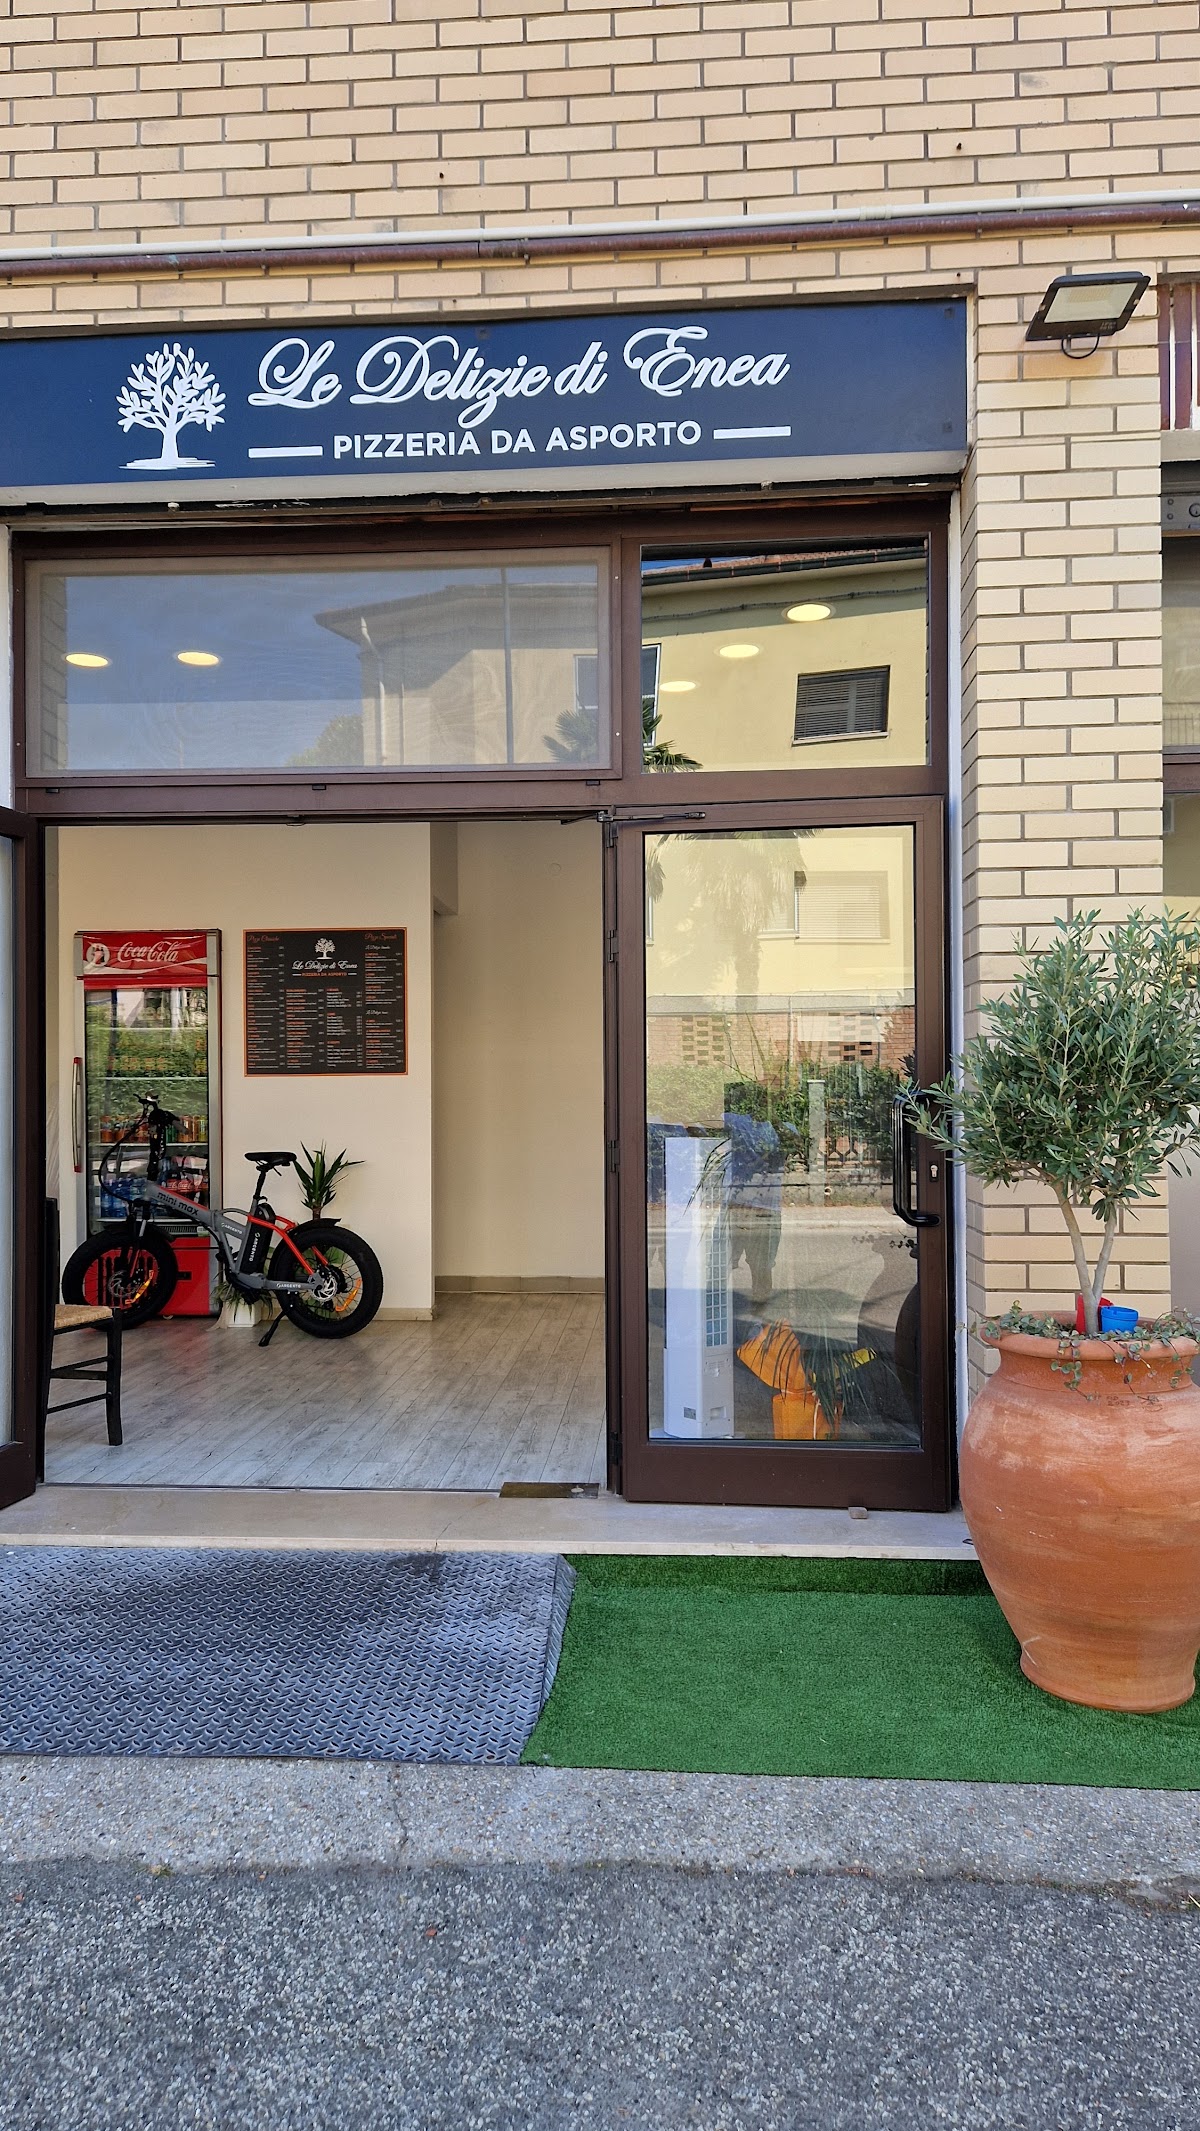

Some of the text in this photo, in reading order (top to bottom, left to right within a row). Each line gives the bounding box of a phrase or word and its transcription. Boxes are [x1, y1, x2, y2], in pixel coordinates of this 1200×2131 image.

[248, 326, 790, 429] Le Delizie di Enea
[333, 420, 702, 459] PIZZERIA DA ASPORTO
[157, 1192, 199, 1217] mini max
[224, 1224, 243, 1235] ARGENTO
[249, 1238, 259, 1262] ARGENTO
